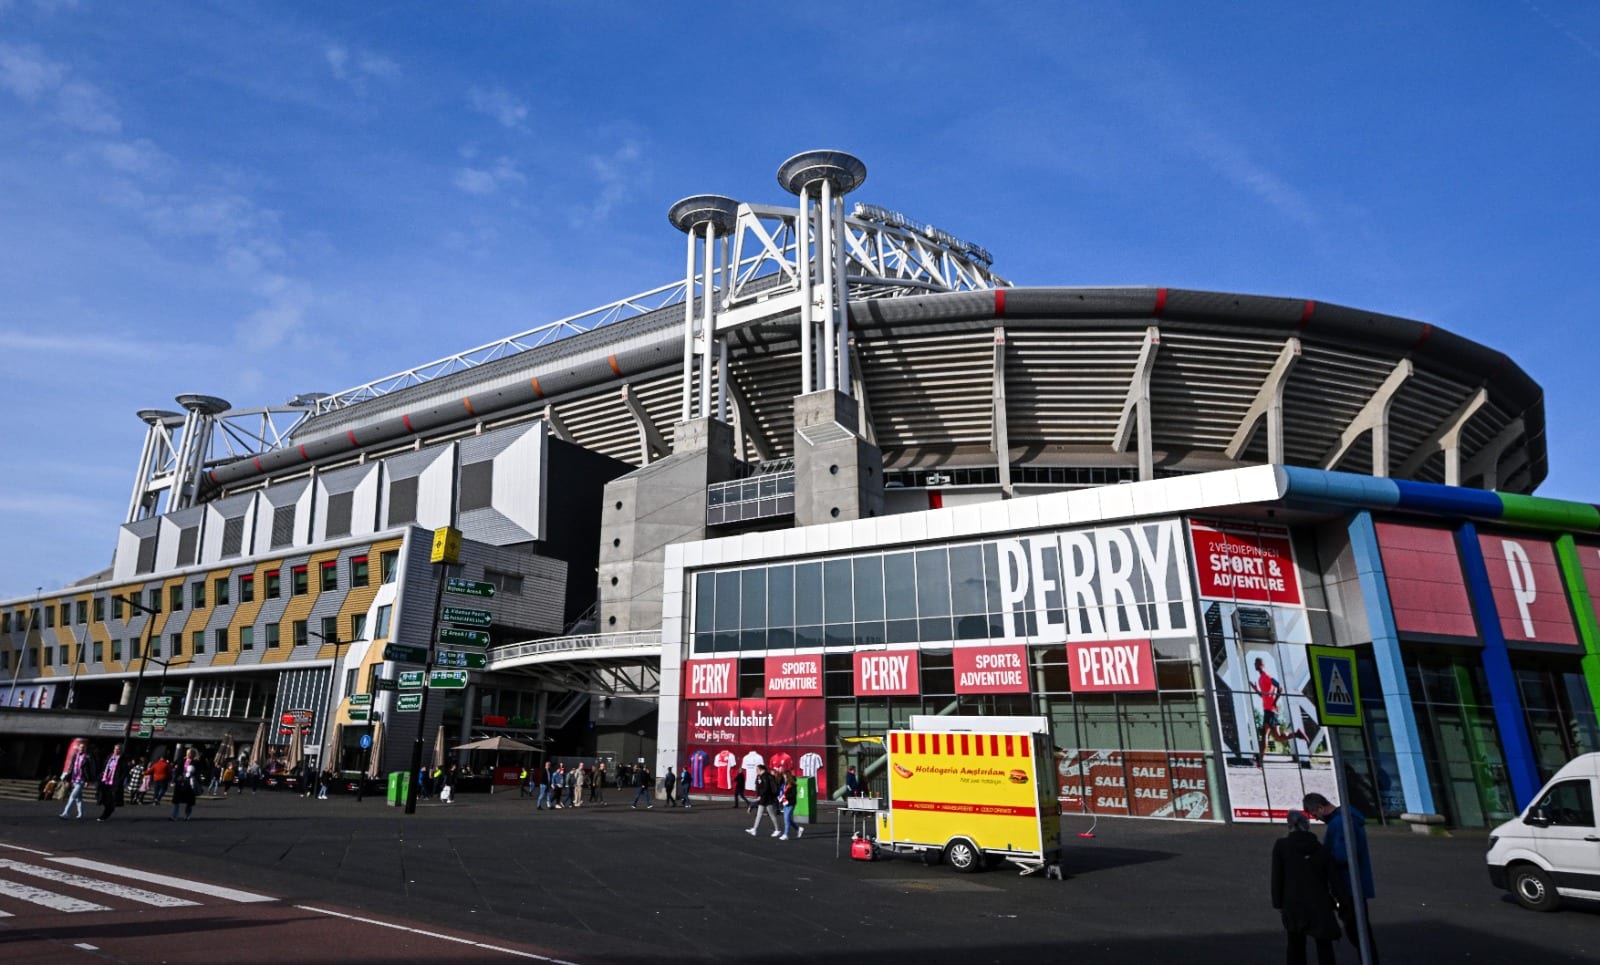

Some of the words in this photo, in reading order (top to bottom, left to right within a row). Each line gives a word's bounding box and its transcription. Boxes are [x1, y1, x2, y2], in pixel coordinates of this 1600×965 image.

[1208, 541, 1214, 552] 2
[1215, 542, 1280, 558] VERDIEPINGEN
[997, 523, 1172, 638] PERRY
[1213, 573, 1285, 592] ADVENTURE
[782, 661, 817, 674] SPORT&
[975, 653, 1021, 669] SPORT&
[1077, 645, 1139, 686] PERRY
[692, 663, 730, 694] PERRY
[861, 655, 909, 691] PERRY
[960, 670, 1022, 686] ADVENTURE
[769, 677, 817, 691] ADVENTURE
[694, 710, 722, 727] Jouw
[723, 709, 774, 727] clubshirt
[694, 730, 706, 739] vind
[705, 731, 712, 742] je
[720, 730, 735, 742] Perry
[1169, 757, 1203, 768] SALE
[915, 765, 958, 775] Hotdogeria
[960, 767, 1005, 776] Amsterdam
[1132, 767, 1166, 778] SALE
[1095, 776, 1125, 787] SALE
[1172, 779, 1206, 790] SALE
[1134, 788, 1168, 799] SALE
[1097, 797, 1128, 808] SALE
